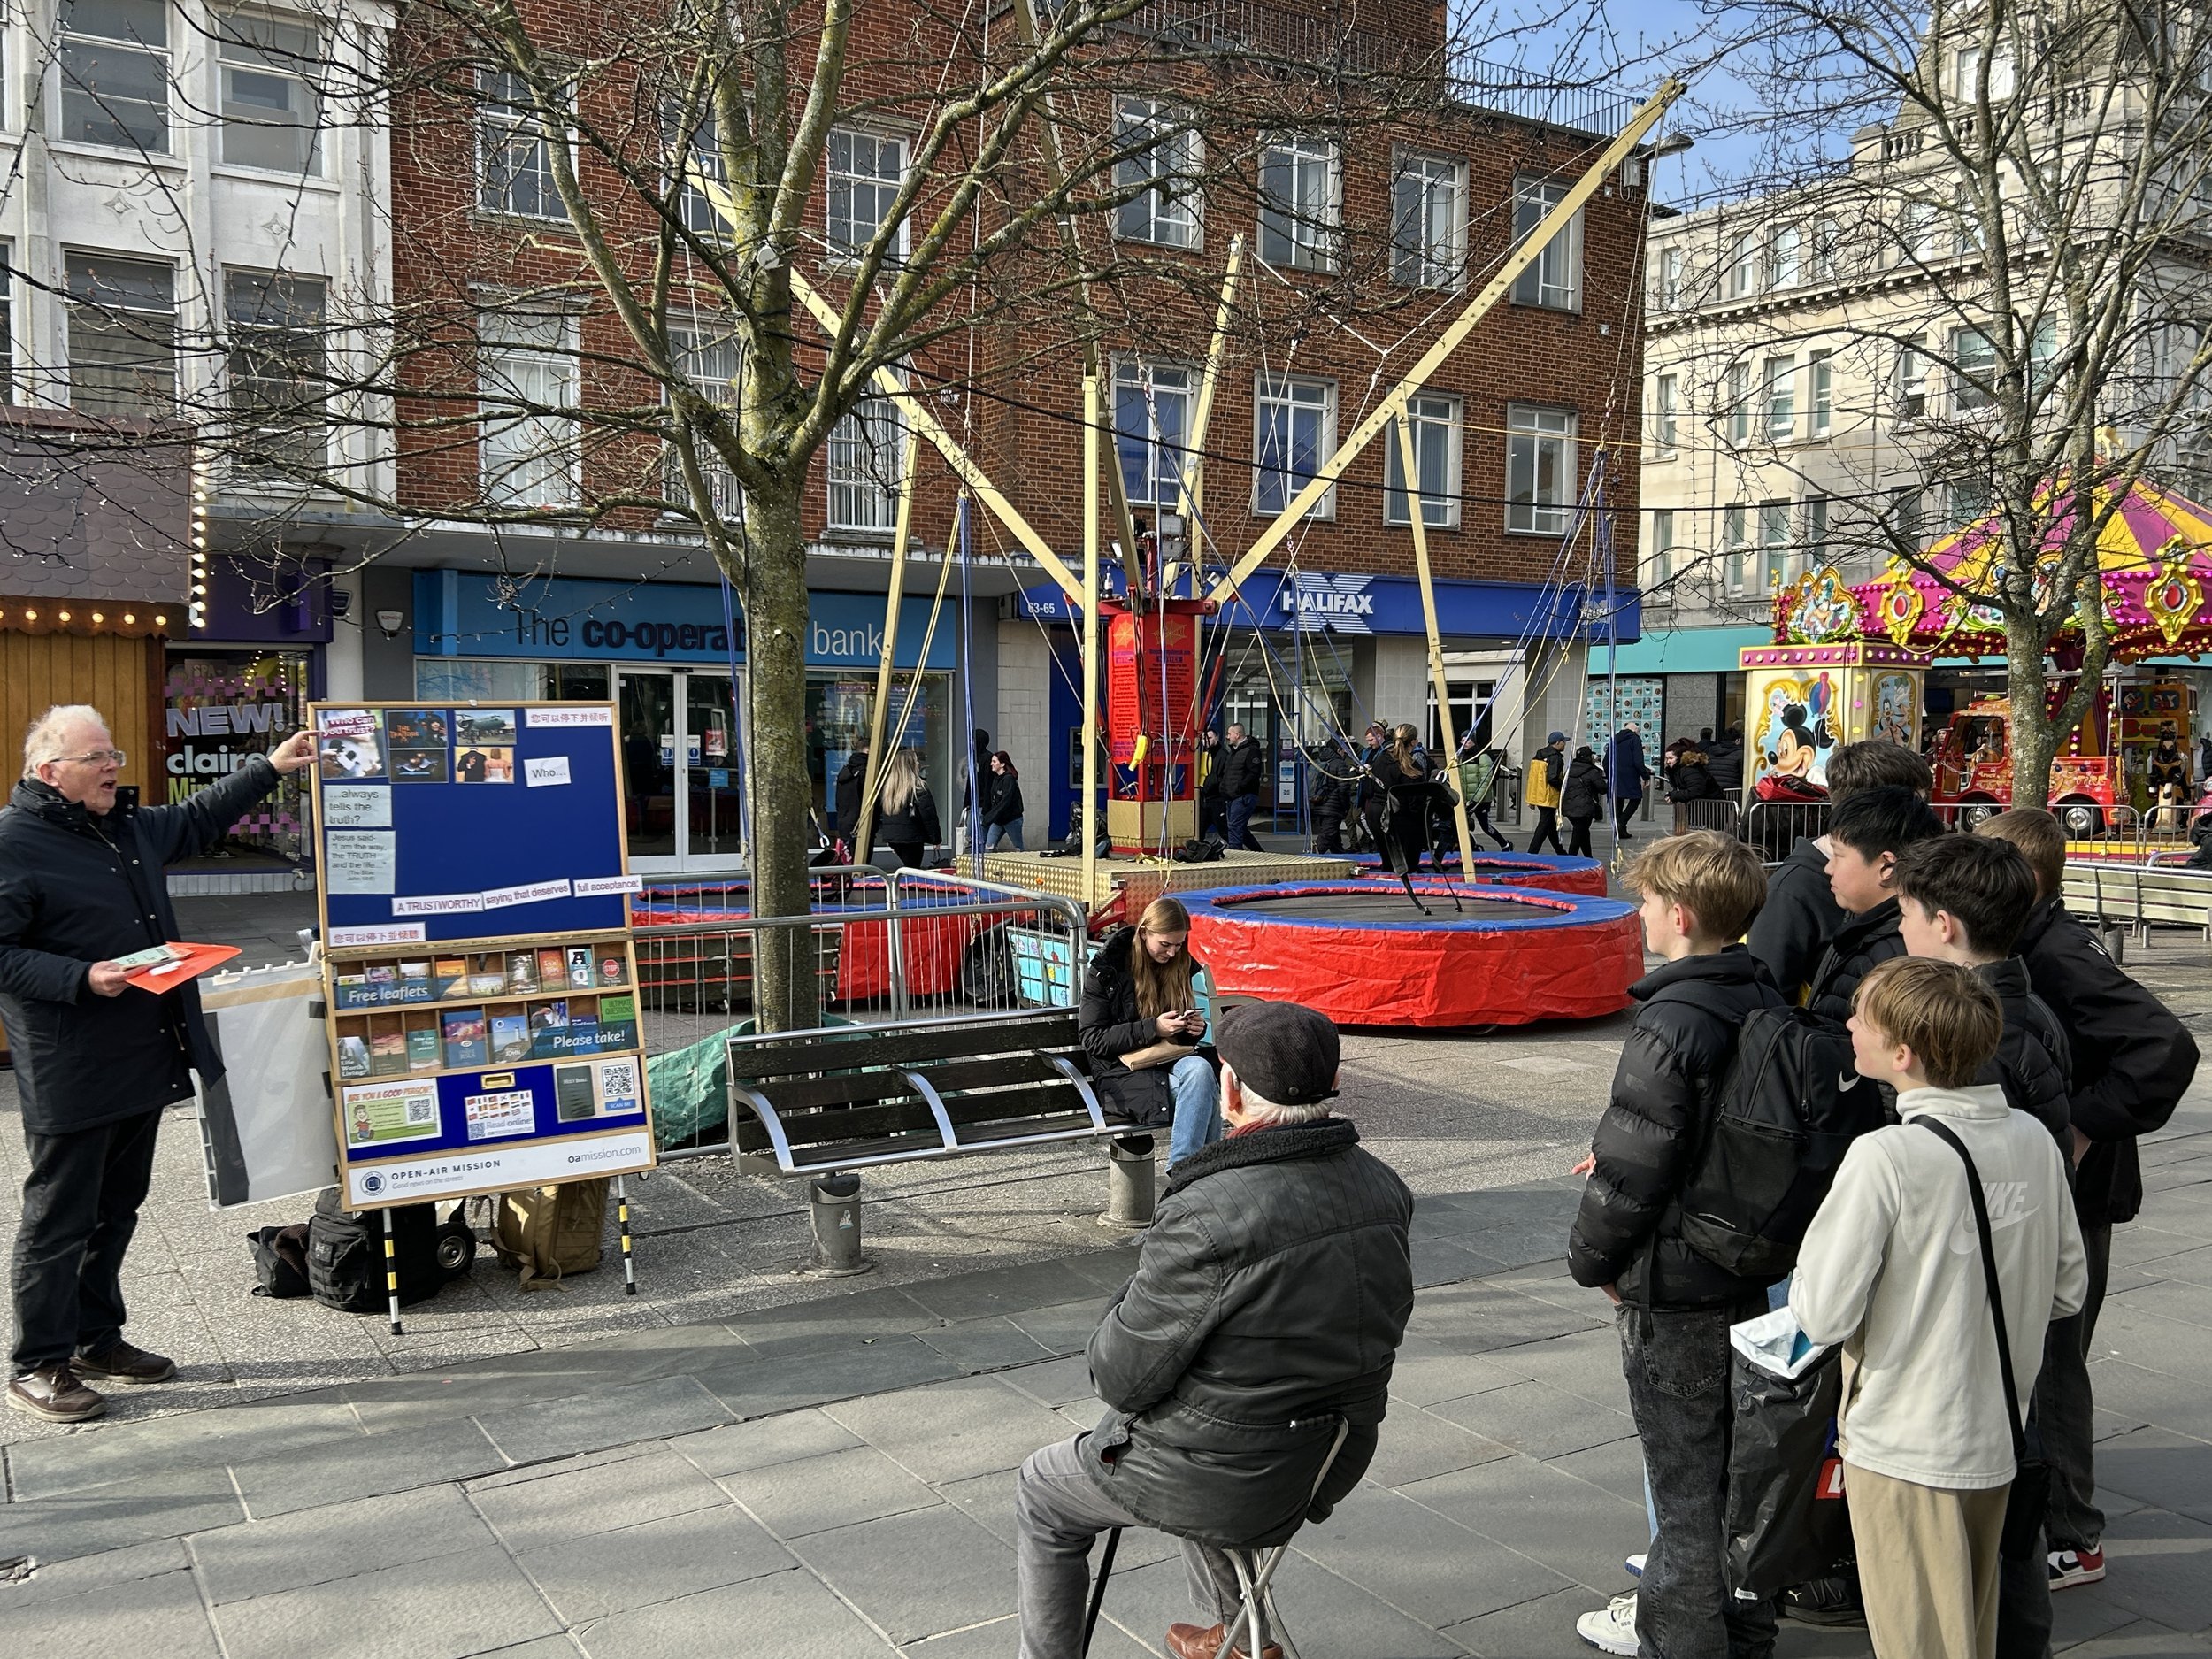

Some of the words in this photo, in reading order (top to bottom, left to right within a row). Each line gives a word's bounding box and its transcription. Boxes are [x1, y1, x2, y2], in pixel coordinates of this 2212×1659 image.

[1027, 602, 1056, 615] 63-65
[1281, 590, 1374, 614] HALIFAX
[509, 608, 570, 646] The
[582, 618, 746, 657] co-operat
[812, 620, 883, 657] bank
[165, 703, 286, 737] NEW!
[323, 727, 344, 737] you
[345, 726, 376, 735] trust?
[329, 803, 351, 811] tells
[354, 803, 372, 811] the
[329, 815, 361, 825] truth?
[396, 903, 405, 912] A
[406, 898, 480, 911] TRUSTWORTHY
[486, 893, 513, 905] saying
[514, 889, 530, 900] that
[531, 884, 569, 897] deserves
[577, 883, 589, 893] full
[572, 951, 587, 965] A
[572, 969, 589, 986] Q
[349, 989, 379, 1002] Free
[380, 986, 428, 1000] leaflets
[553, 1034, 593, 1048] Please
[595, 1030, 626, 1045] take!
[362, 1091, 376, 1101] YOU
[382, 1088, 403, 1098] GOOD
[391, 1166, 448, 1180] OPEN-AIR
[452, 1159, 501, 1173] MISSION
[567, 1146, 641, 1164] oamission.com
